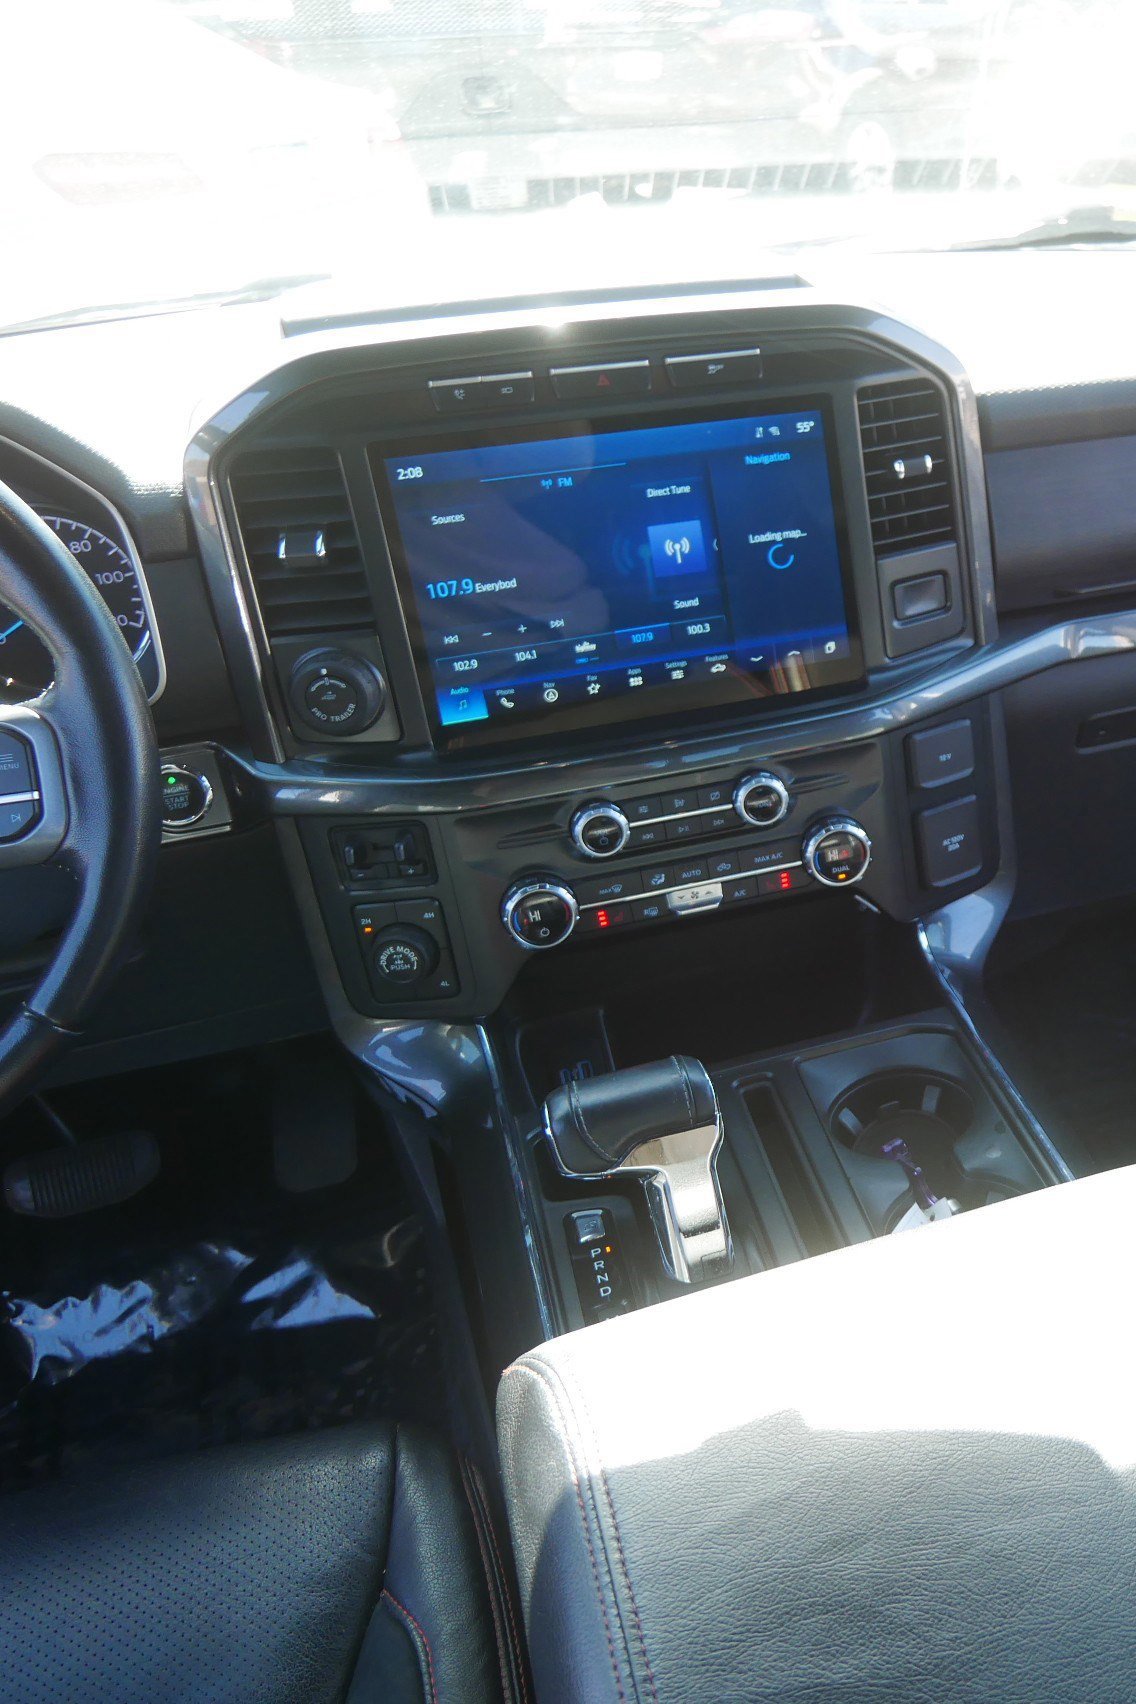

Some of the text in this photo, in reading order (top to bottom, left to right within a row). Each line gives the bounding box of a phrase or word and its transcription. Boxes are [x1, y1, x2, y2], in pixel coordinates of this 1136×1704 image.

[796, 420, 815, 433] 55°
[745, 451, 791, 466] Navigation
[396, 466, 424, 480] 2:08
[558, 477, 573, 488] FM
[646, 484, 691, 498] Direct Tune
[431, 512, 465, 526] Sources
[748, 530, 783, 544] Loading
[69, 539, 92, 554] 80
[95, 570, 124, 585] 100
[426, 577, 517, 600] 107.9 Everybod
[673, 597, 699, 610] Sound
[686, 623, 711, 636] 100.3
[631, 631, 654, 643] 107.9
[514, 649, 537, 662] 104.1
[453, 658, 478, 672] 102.9
[450, 686, 469, 696] Audio
[543, 682, 556, 690] Nav
[311, 703, 357, 722] PRO TRAILER
[163, 784, 190, 794] NGINE
[754, 851, 784, 864] MAX A/C
[682, 869, 702, 879] AUTO
[832, 864, 850, 874] DUAL
[733, 888, 747, 898] A/C
[528, 910, 542, 923] HI
[380, 945, 418, 965] DRIVE MODE
[591, 1247, 602, 1258] P
[594, 1260, 605, 1270] R
[596, 1273, 609, 1284] N
[600, 1286, 612, 1297] D
